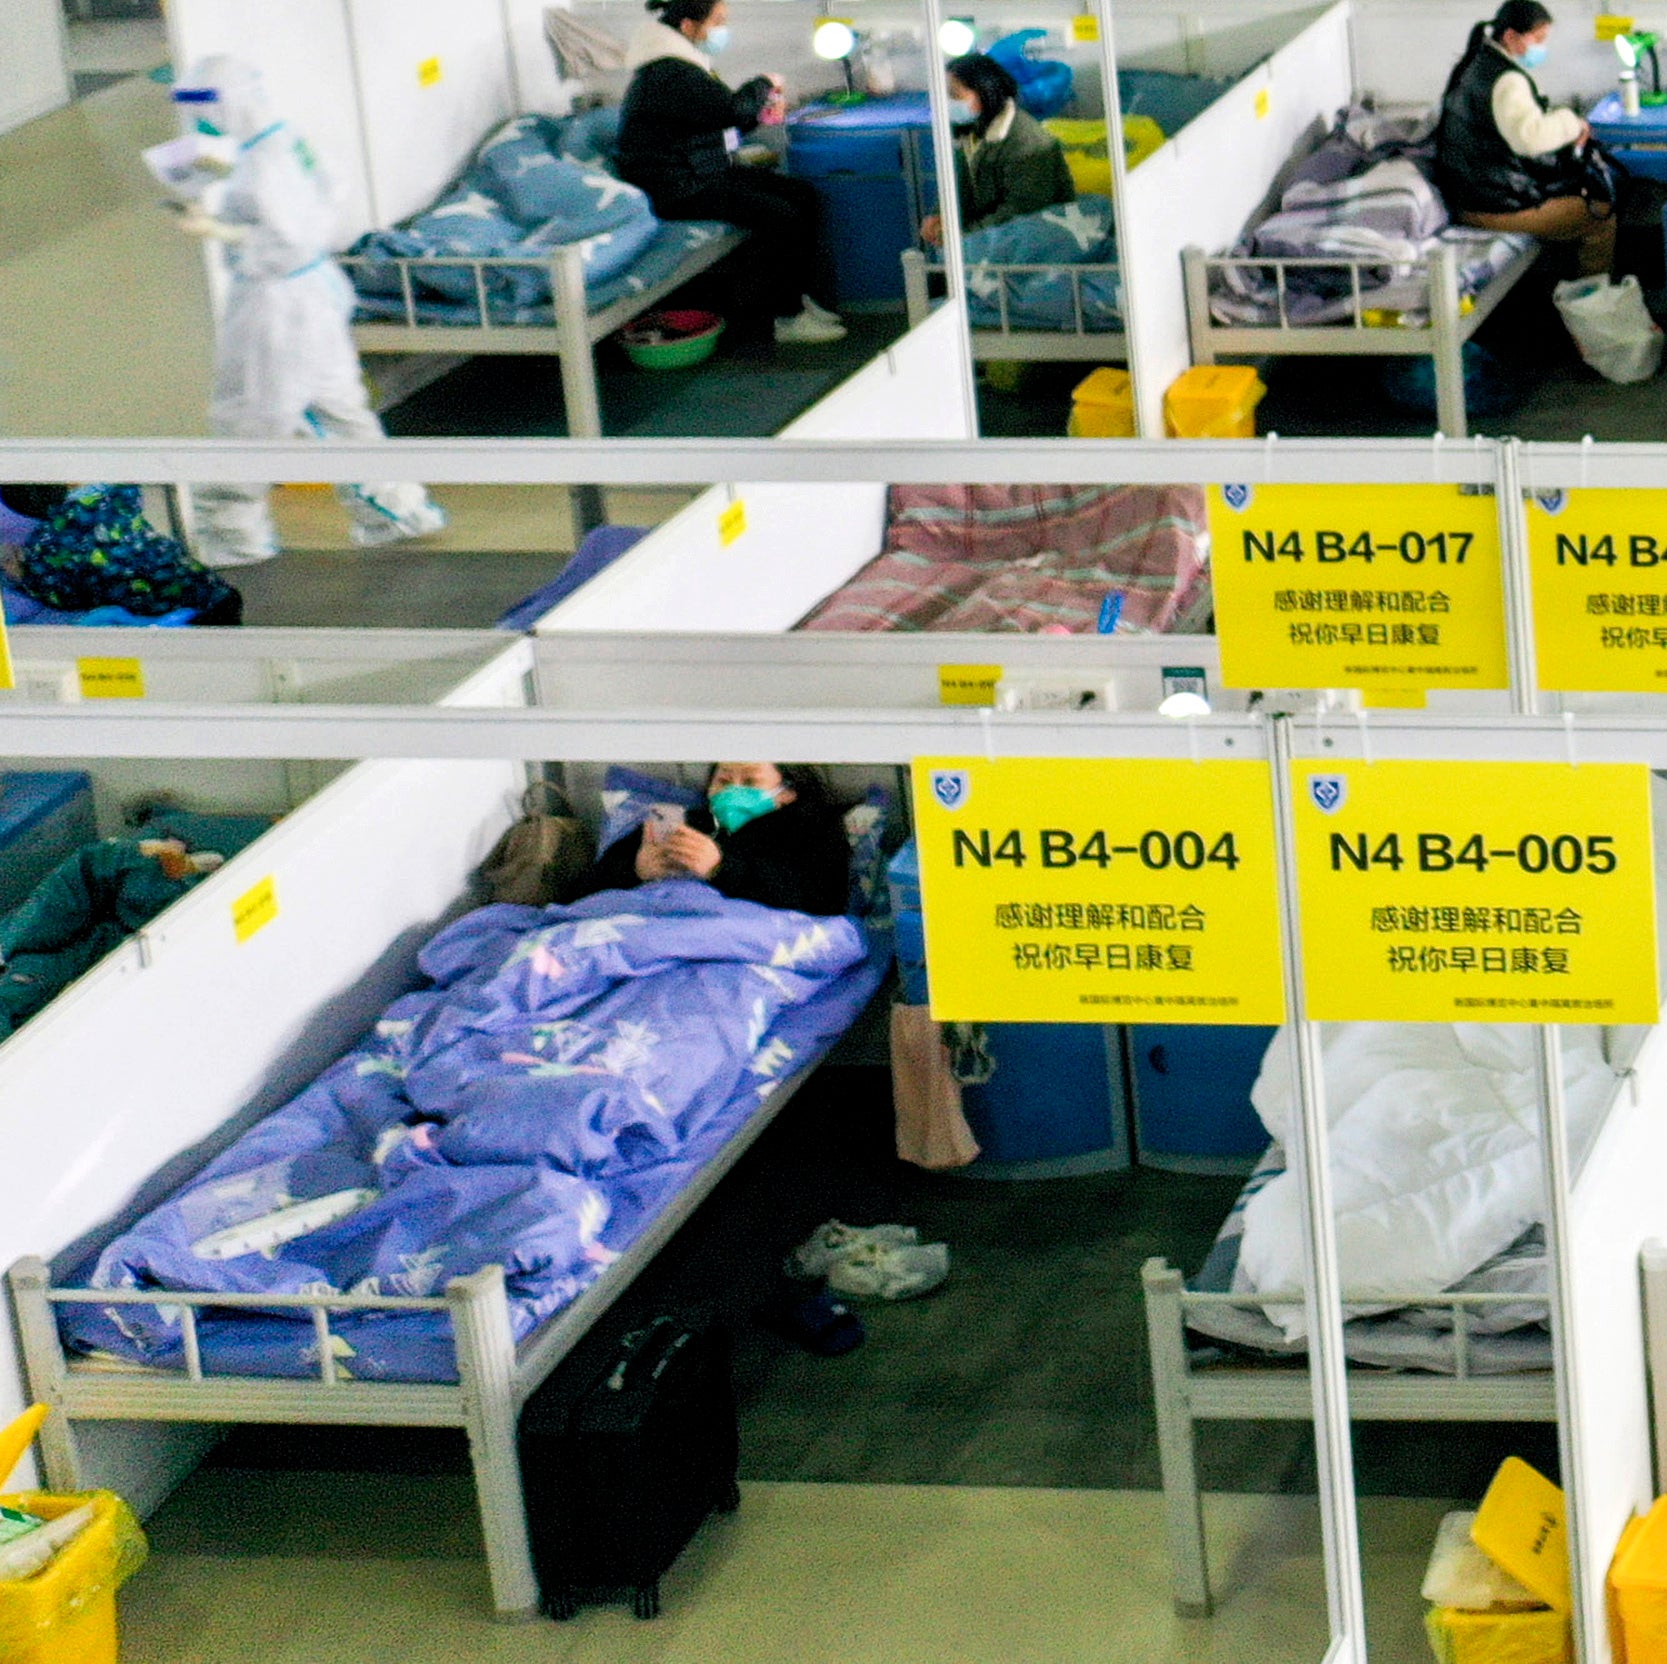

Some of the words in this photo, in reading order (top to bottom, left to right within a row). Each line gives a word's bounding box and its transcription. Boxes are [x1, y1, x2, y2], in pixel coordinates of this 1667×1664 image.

[1243, 531, 1304, 564] N4
[1316, 531, 1474, 564] B4-017
[1556, 534, 1617, 570] N4
[1275, 590, 1450, 613] 感谢理解和配合
[1290, 623, 1439, 645] 祝你早日康复
[953, 830, 1026, 870] N4
[1041, 830, 1239, 870] B4-004
[1330, 833, 1403, 874] N4
[1418, 833, 1616, 874] B4-005
[996, 903, 1205, 931] 感谢理解和配合
[1372, 906, 1581, 934] 感谢理解和配合
[1014, 944, 1192, 970] 祝你早日康复
[1388, 947, 1568, 974] 祝你早日康复
